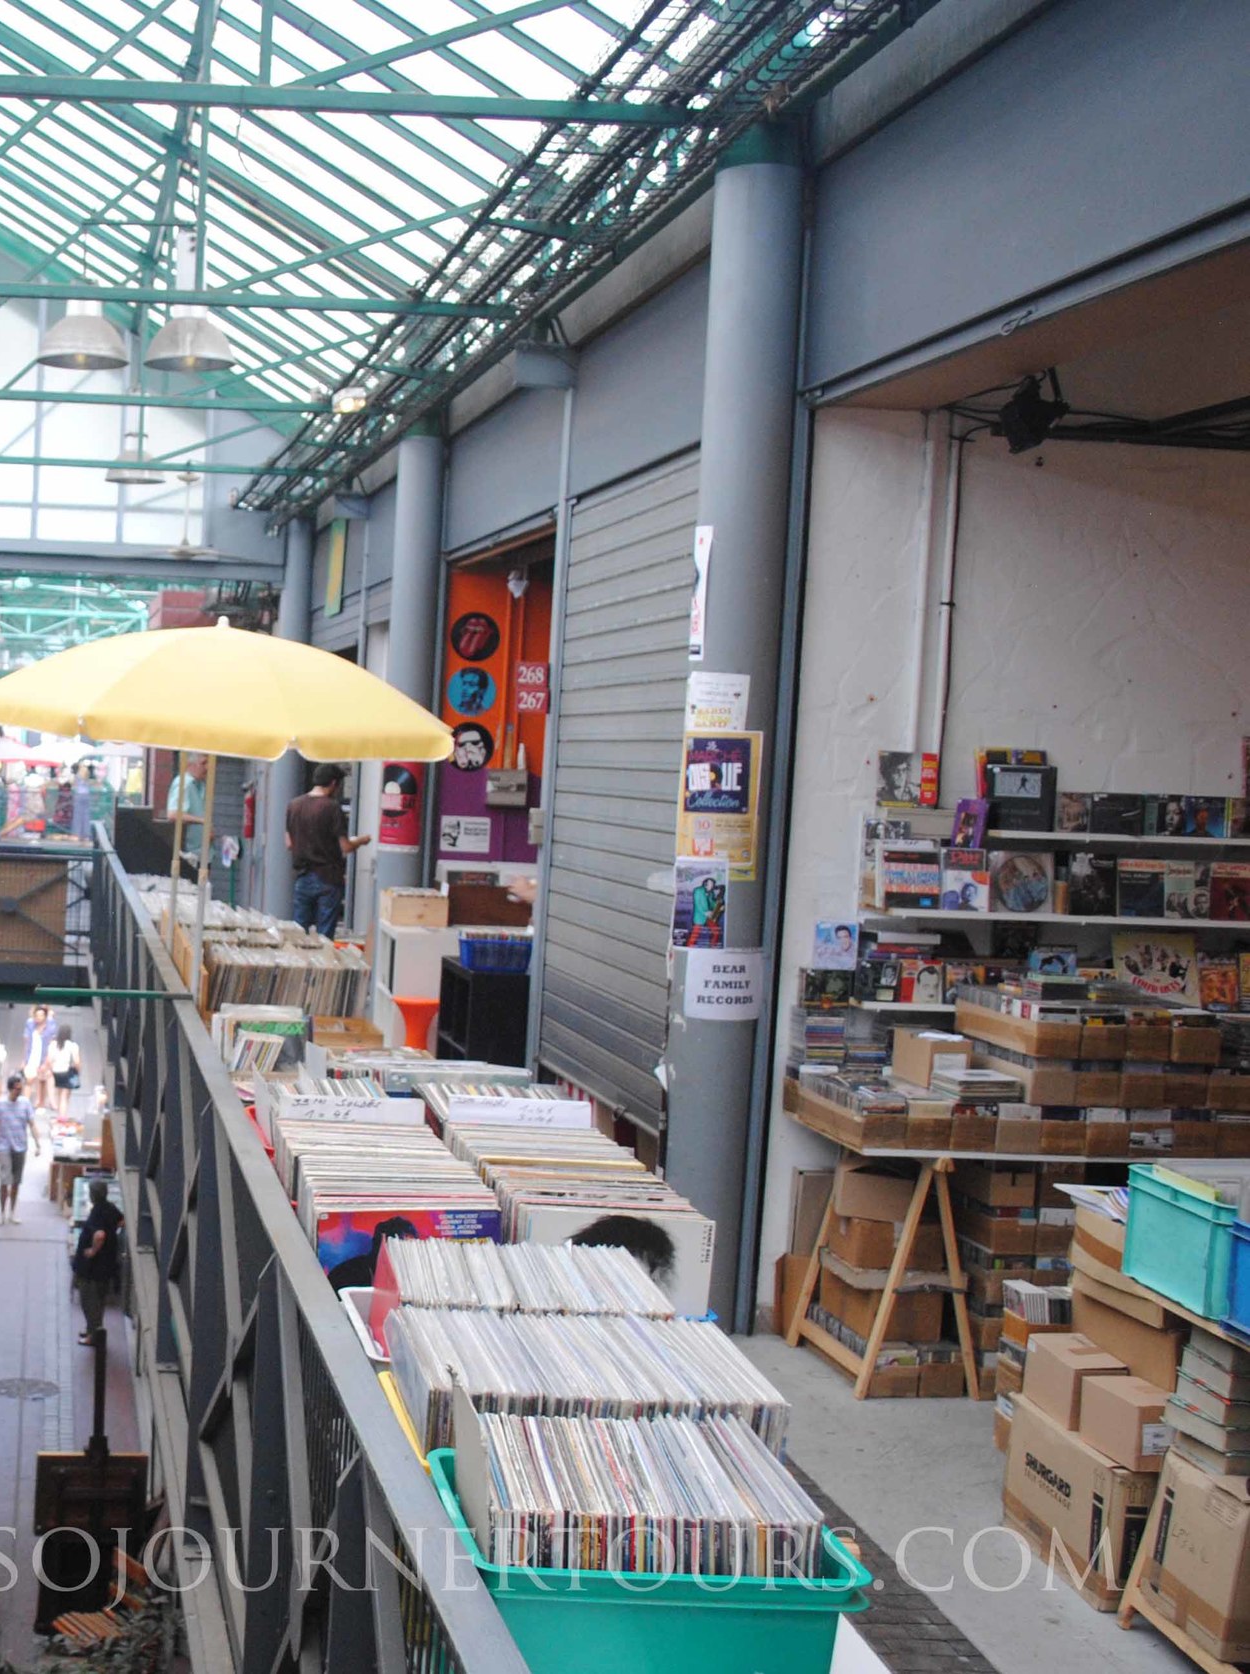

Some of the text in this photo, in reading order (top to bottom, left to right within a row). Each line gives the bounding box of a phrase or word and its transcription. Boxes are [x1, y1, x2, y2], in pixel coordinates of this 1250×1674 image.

[518, 666, 545, 683] 268
[518, 691, 546, 709] 267
[688, 791, 741, 808] Collection
[712, 965, 746, 973] BEAR
[704, 980, 751, 989] FAMILY
[697, 996, 754, 1004] RECORDS
[1025, 1452, 1071, 1498] SHURGARD
